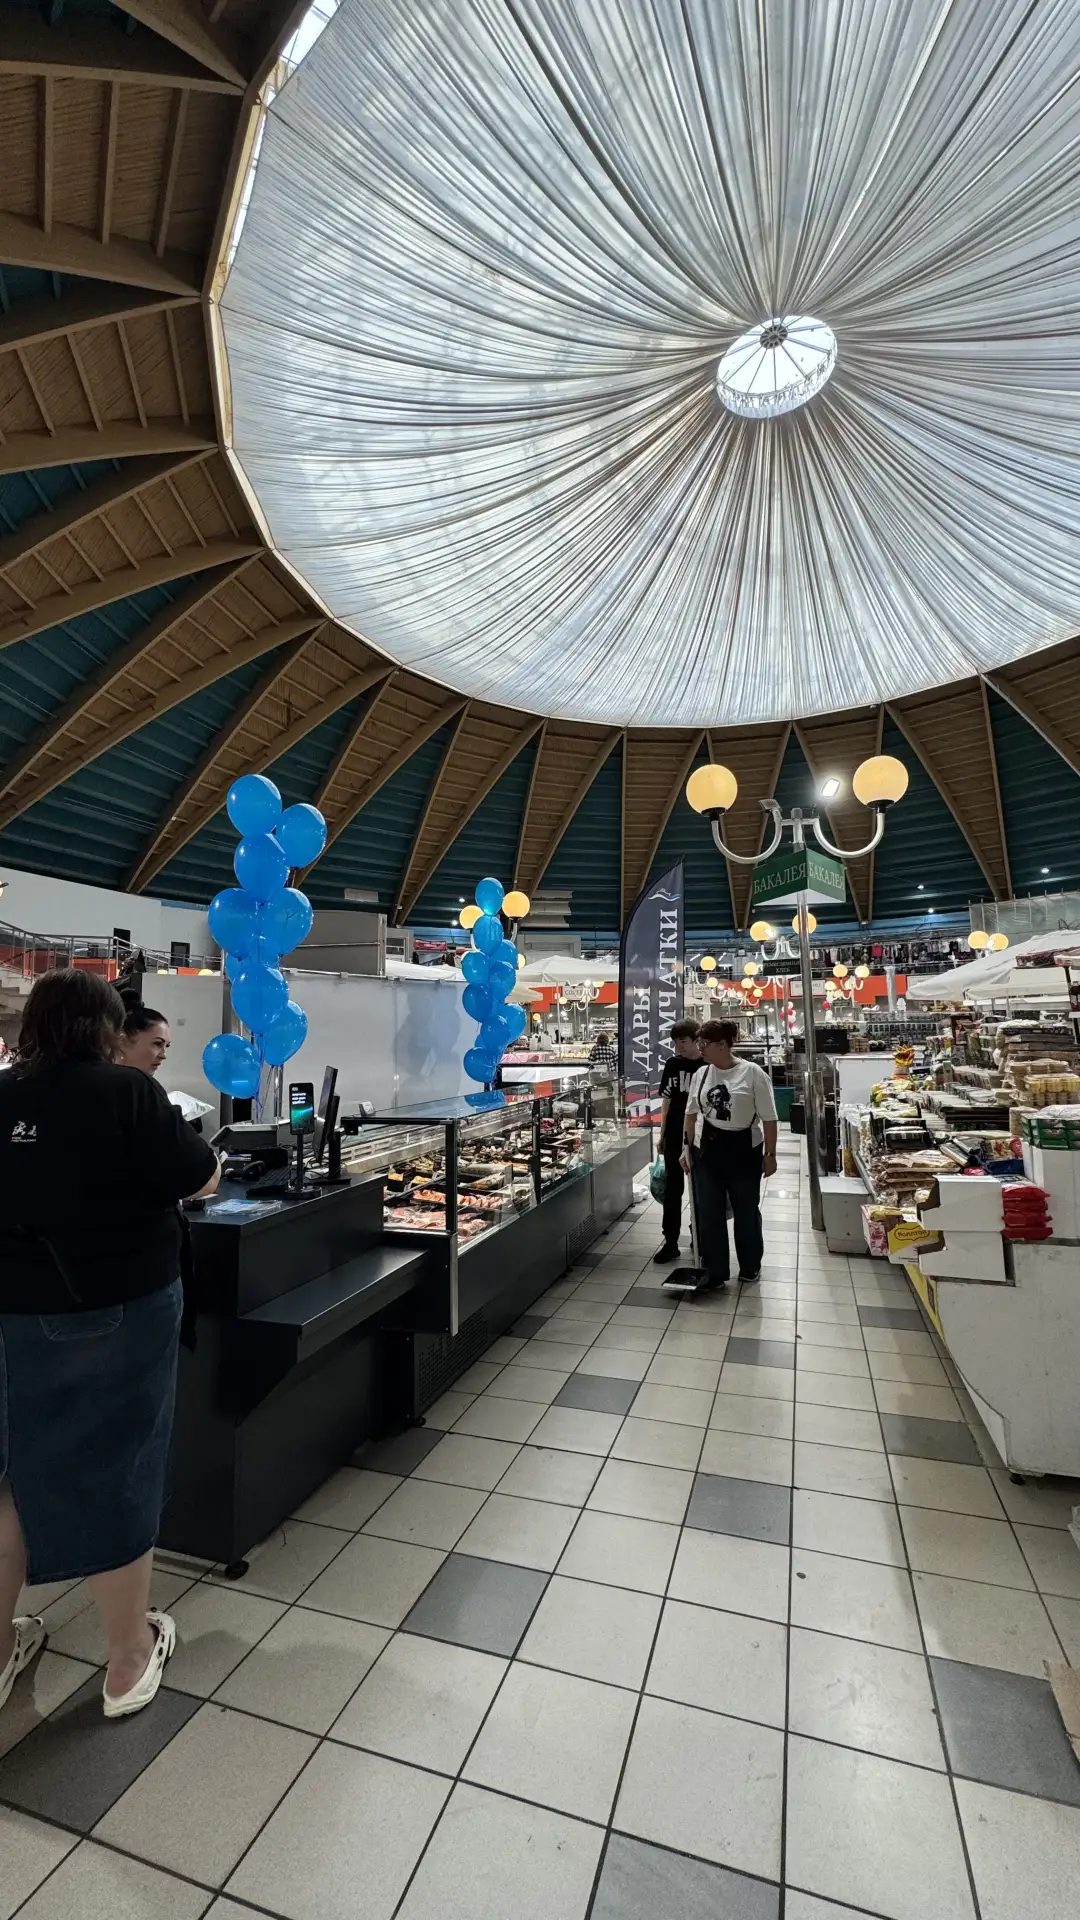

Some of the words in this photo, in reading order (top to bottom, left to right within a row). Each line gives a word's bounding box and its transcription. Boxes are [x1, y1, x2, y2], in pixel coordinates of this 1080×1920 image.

[753, 862, 807, 895] БАКАЛЕЯ
[808, 861, 846, 890] БАКАЛЕЯ
[632, 985, 654, 1072] ДАРЫ
